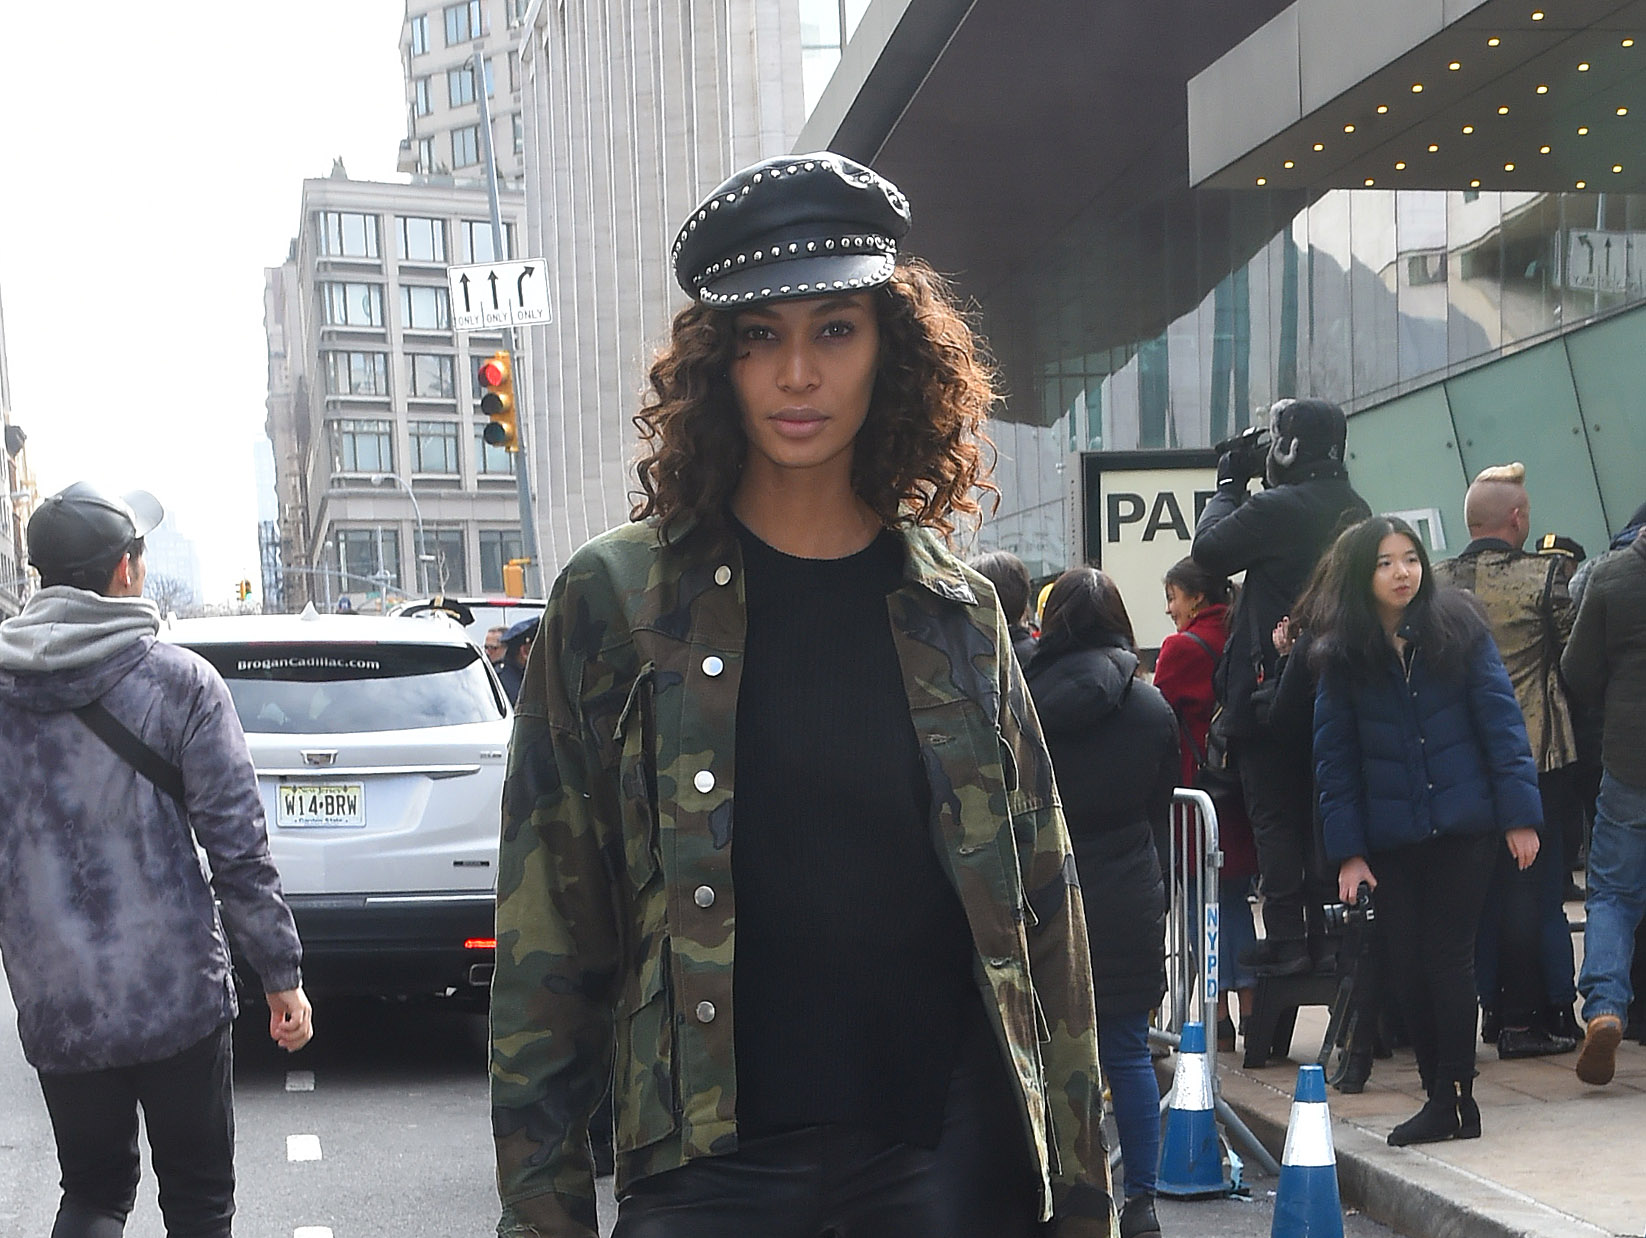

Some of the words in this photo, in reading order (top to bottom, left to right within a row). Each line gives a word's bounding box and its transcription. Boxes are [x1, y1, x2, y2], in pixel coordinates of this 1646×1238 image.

[458, 315, 480, 326] ONLY
[486, 313, 507, 323] ONLY
[517, 309, 543, 320] ONLY
[1106, 491, 1217, 543] PA
[237, 657, 380, 671] BroganCadillac.com
[1206, 907, 1218, 998] NYPD
